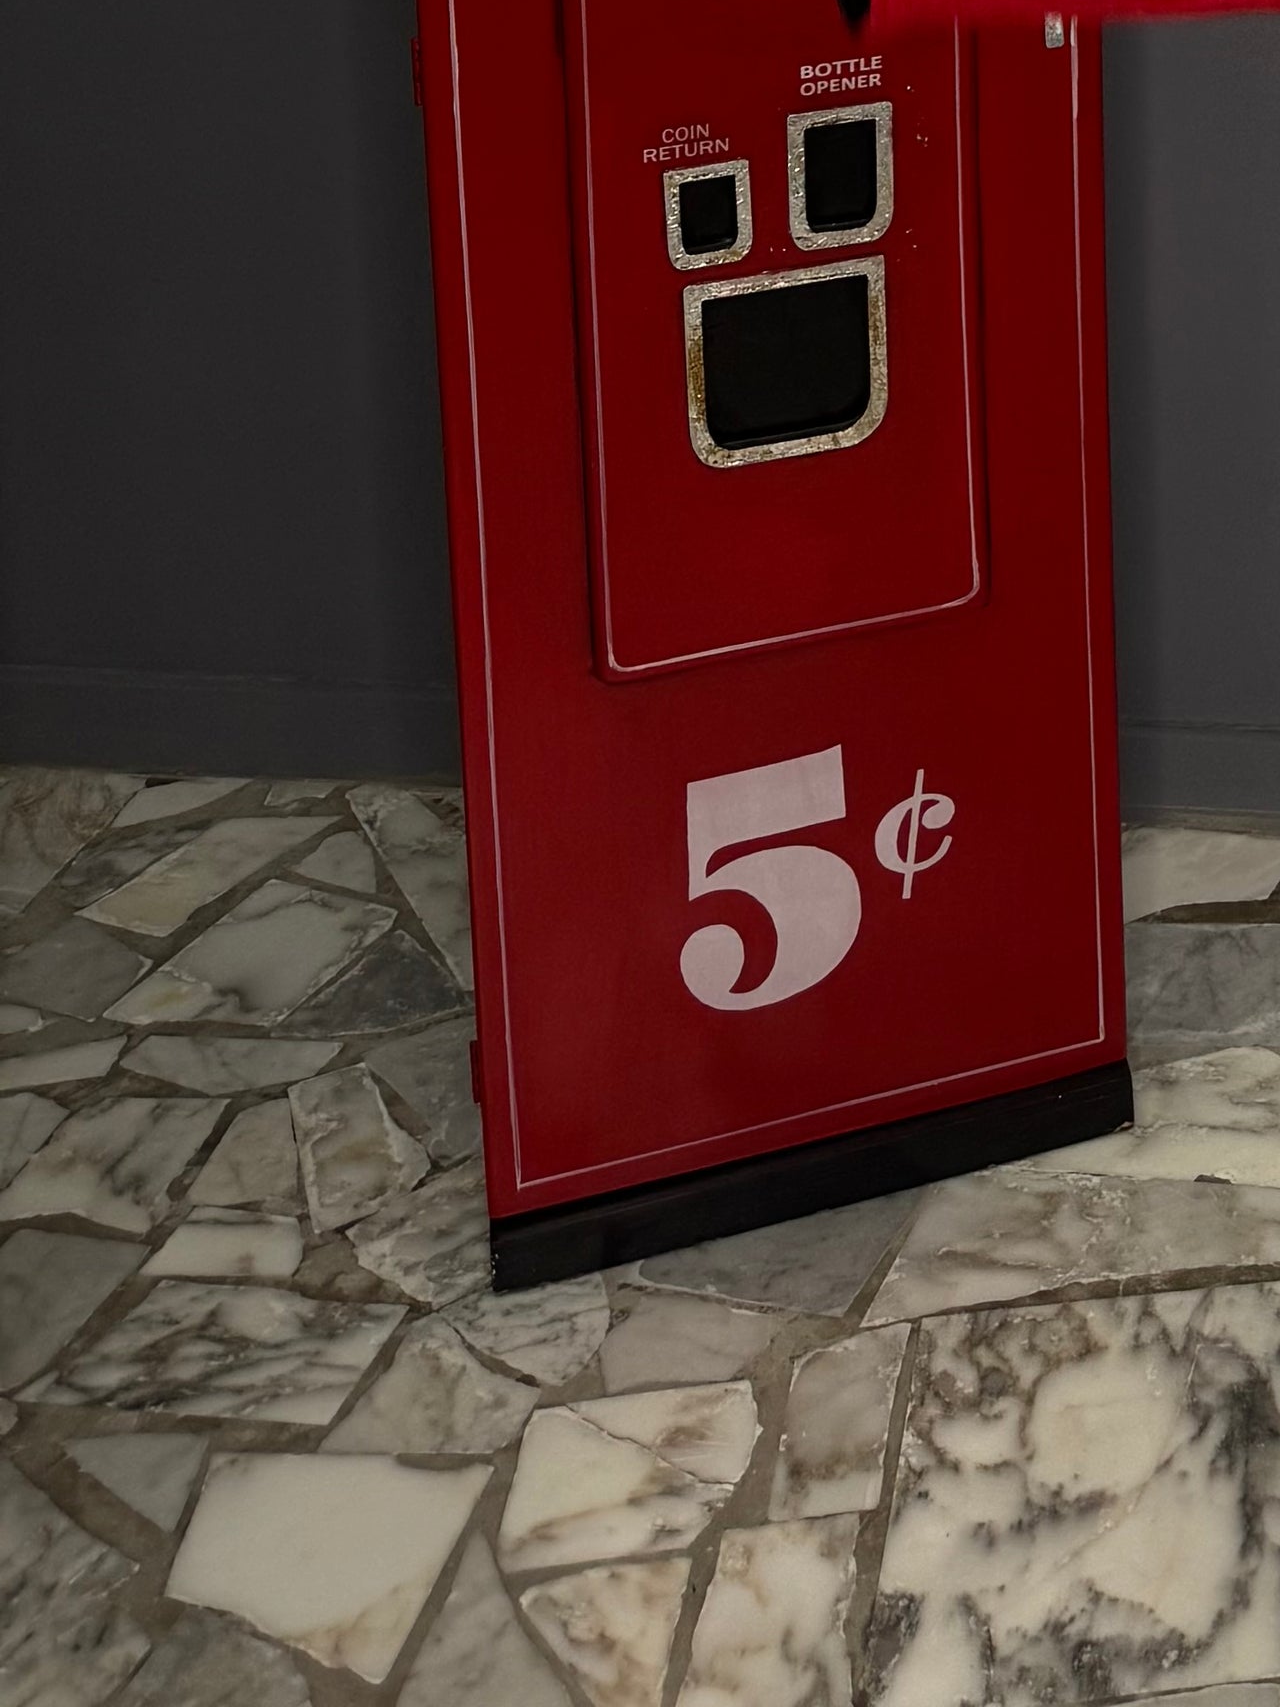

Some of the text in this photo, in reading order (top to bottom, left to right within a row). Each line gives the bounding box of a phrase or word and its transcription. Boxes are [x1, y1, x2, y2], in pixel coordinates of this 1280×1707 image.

[800, 55, 883, 80] BOTTLE
[800, 73, 882, 97] OPENER
[661, 122, 710, 144] COIN
[642, 137, 730, 164] RETURN
